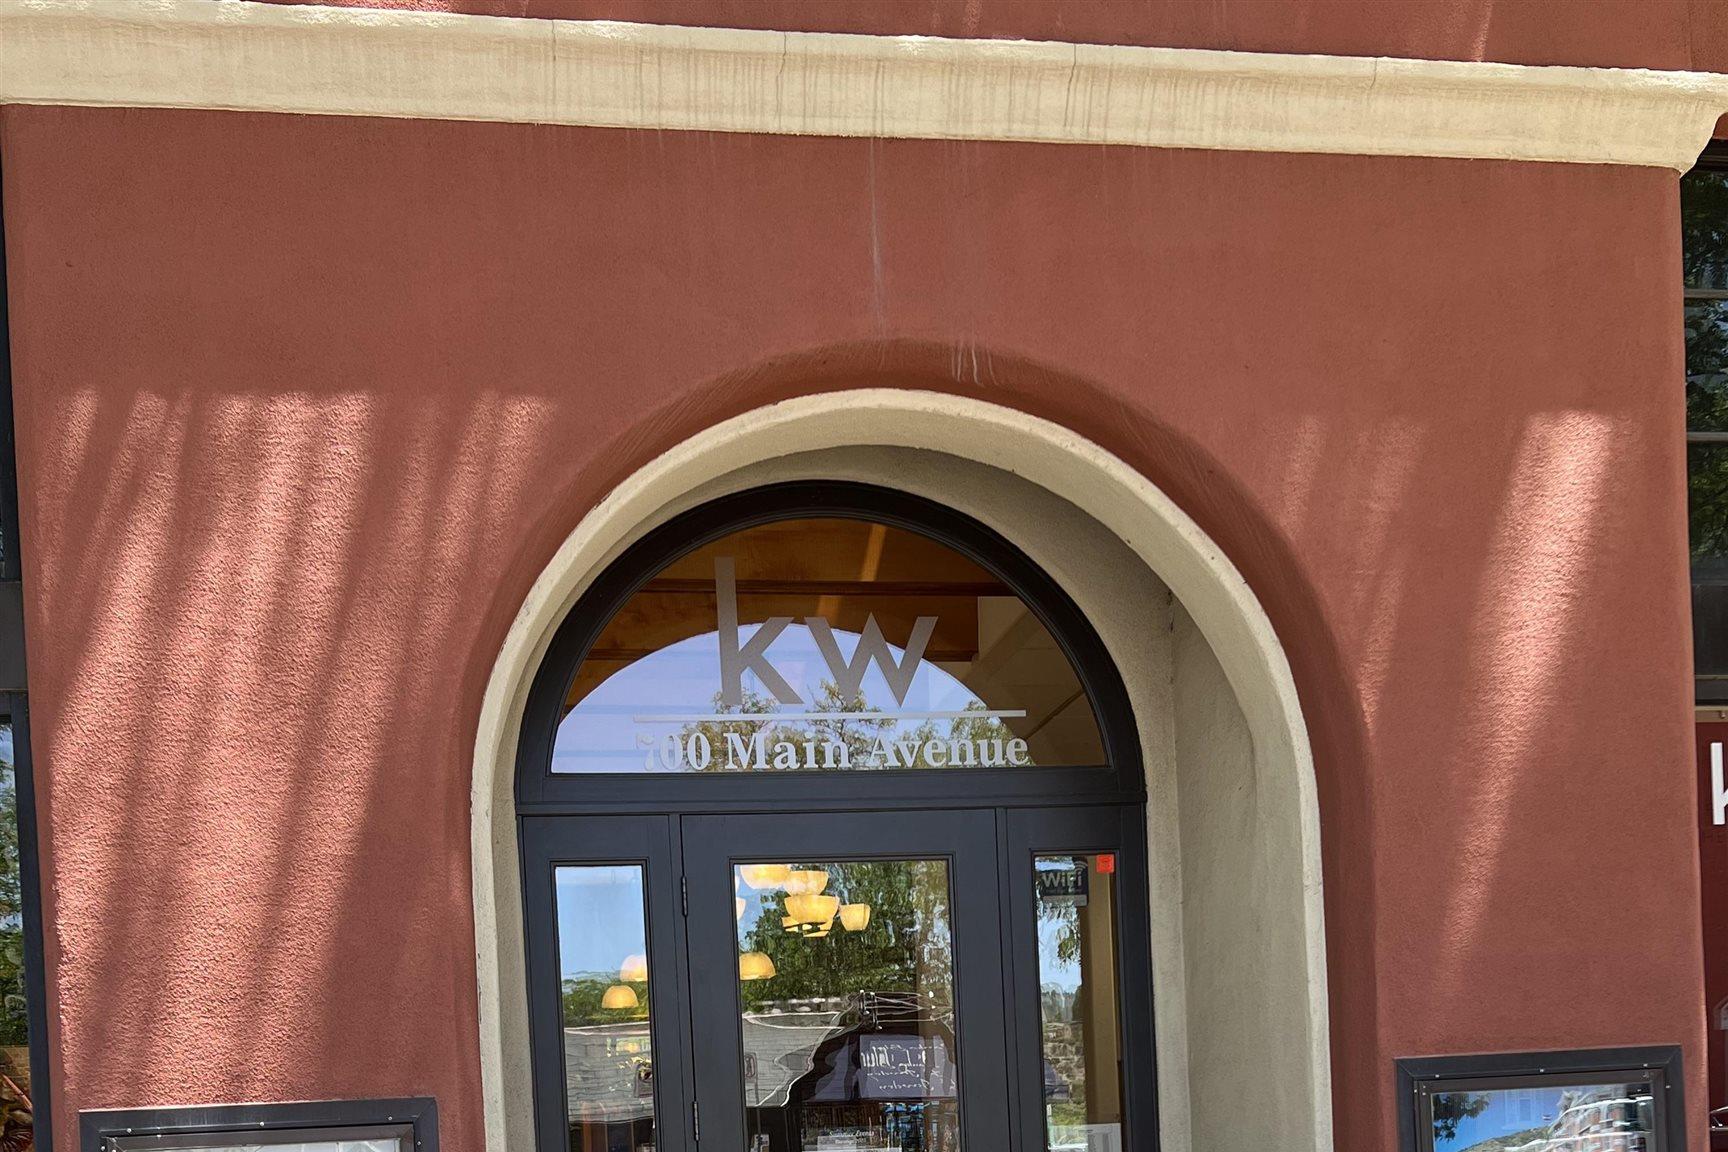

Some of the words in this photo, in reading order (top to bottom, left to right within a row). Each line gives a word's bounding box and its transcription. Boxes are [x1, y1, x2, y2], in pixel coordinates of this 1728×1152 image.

[714, 556, 939, 707] kw
[724, 729, 852, 772] Main
[869, 734, 1030, 769] Avenue
